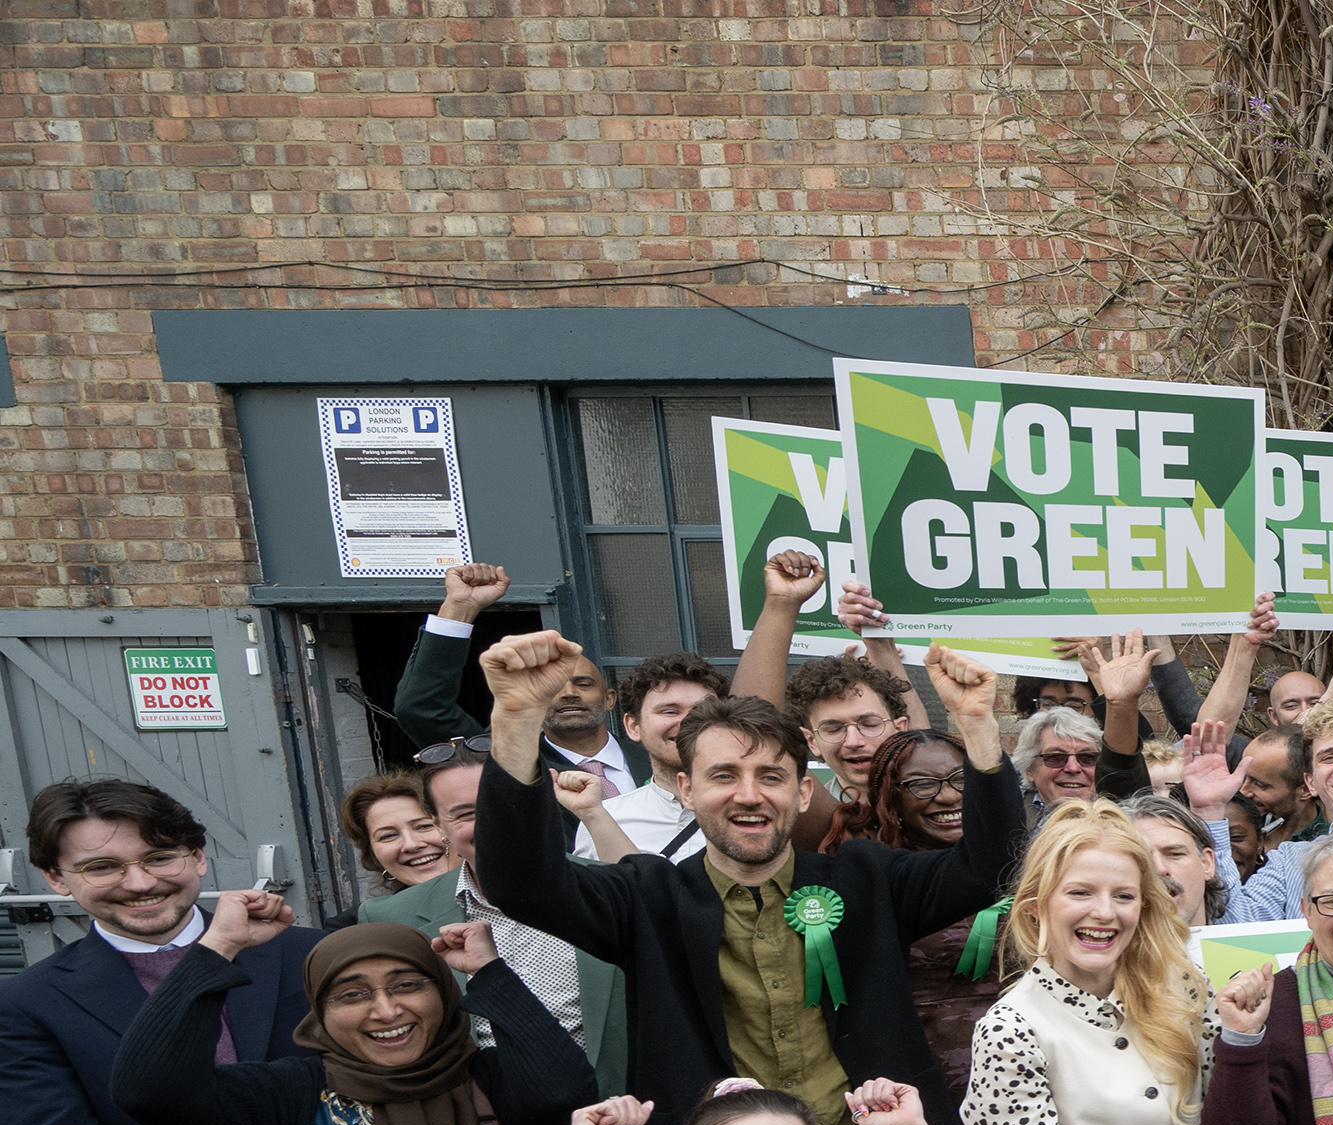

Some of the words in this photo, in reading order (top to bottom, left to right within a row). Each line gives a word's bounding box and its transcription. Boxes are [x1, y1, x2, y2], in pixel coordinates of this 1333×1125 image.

[926, 398, 1196, 498] VOTE
[901, 499, 1226, 589] GREEN
[928, 623, 953, 632] Party
[1180, 620, 1246, 628] www.greenparty.org
[130, 656, 171, 669] FIRE
[173, 656, 213, 668] EXIT
[1009, 662, 1078, 675] www.greenparty.org.uk
[139, 676, 167, 690] DO
[171, 676, 211, 690] NOT
[143, 694, 214, 708] BLOCK
